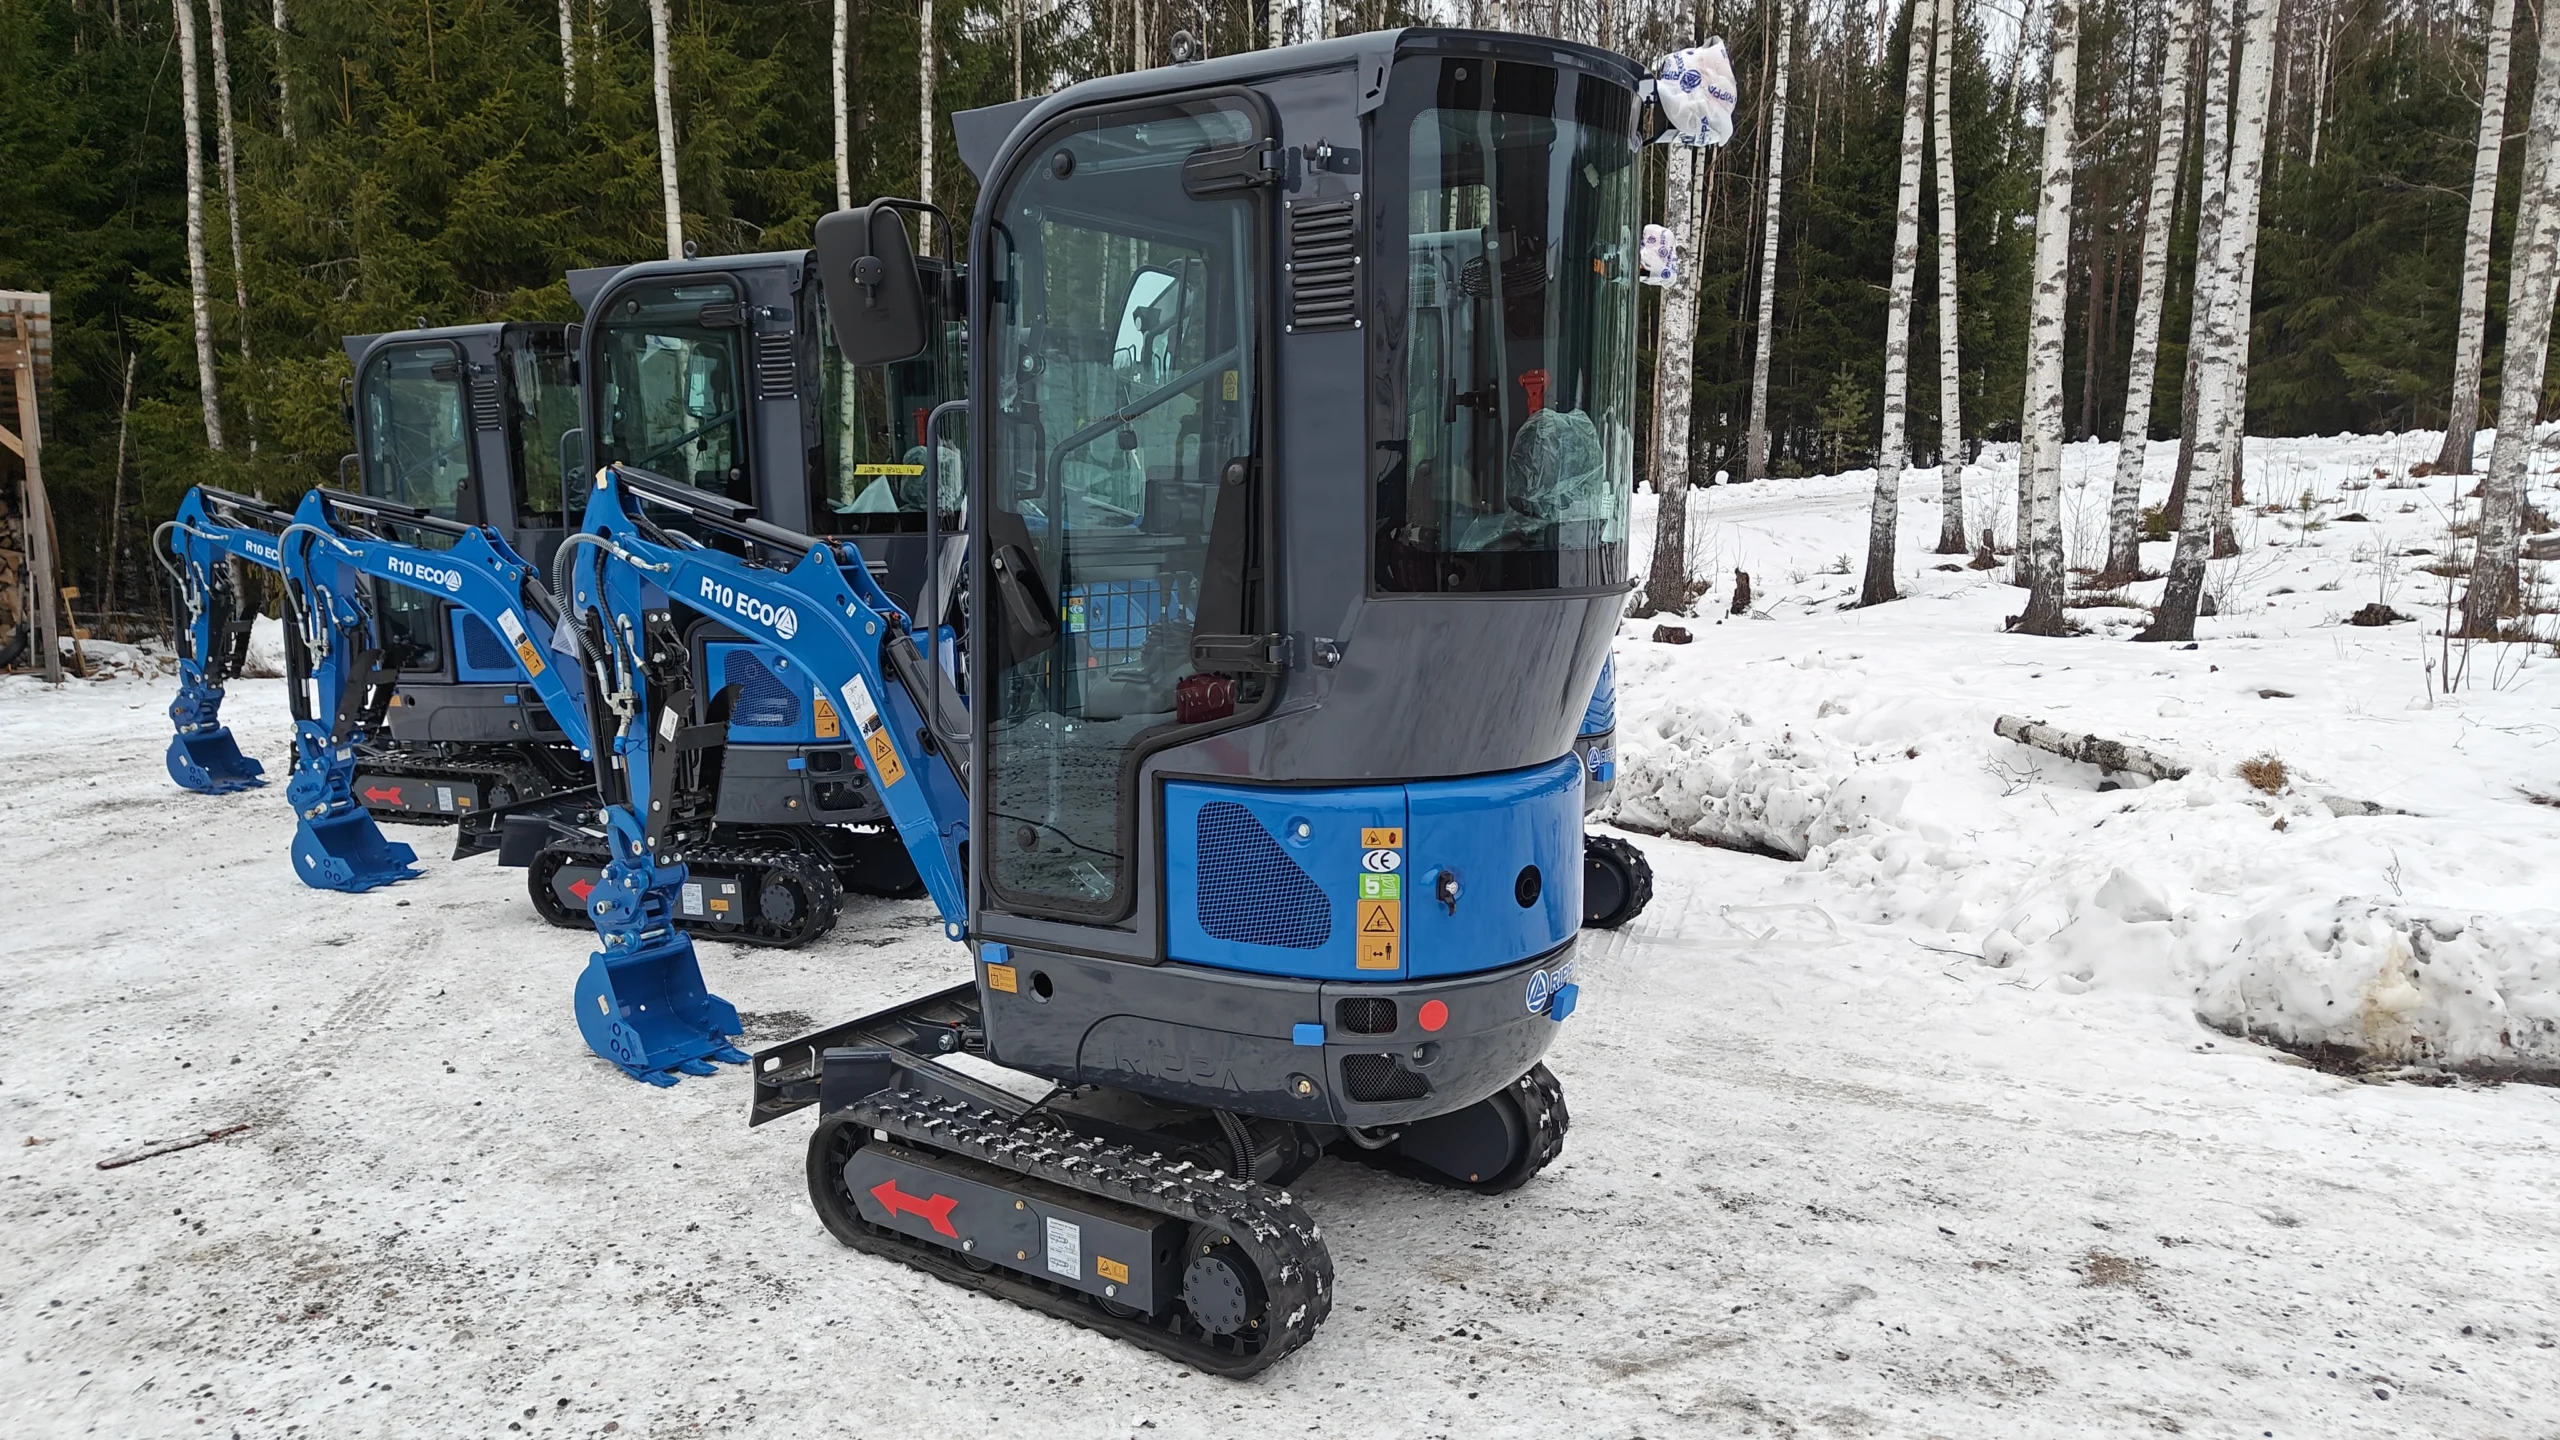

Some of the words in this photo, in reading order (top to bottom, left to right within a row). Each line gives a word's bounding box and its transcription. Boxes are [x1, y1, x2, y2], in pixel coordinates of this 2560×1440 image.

[245, 540, 263, 556] R10
[264, 547, 280, 561] EC
[388, 556, 413, 576] R10
[415, 564, 444, 585] ECO
[700, 576, 733, 608] R10
[736, 592, 774, 627] ECO
[1369, 851, 1391, 870] CE
[1365, 876, 1380, 895] 5
[1550, 956, 1577, 994] RIPP
